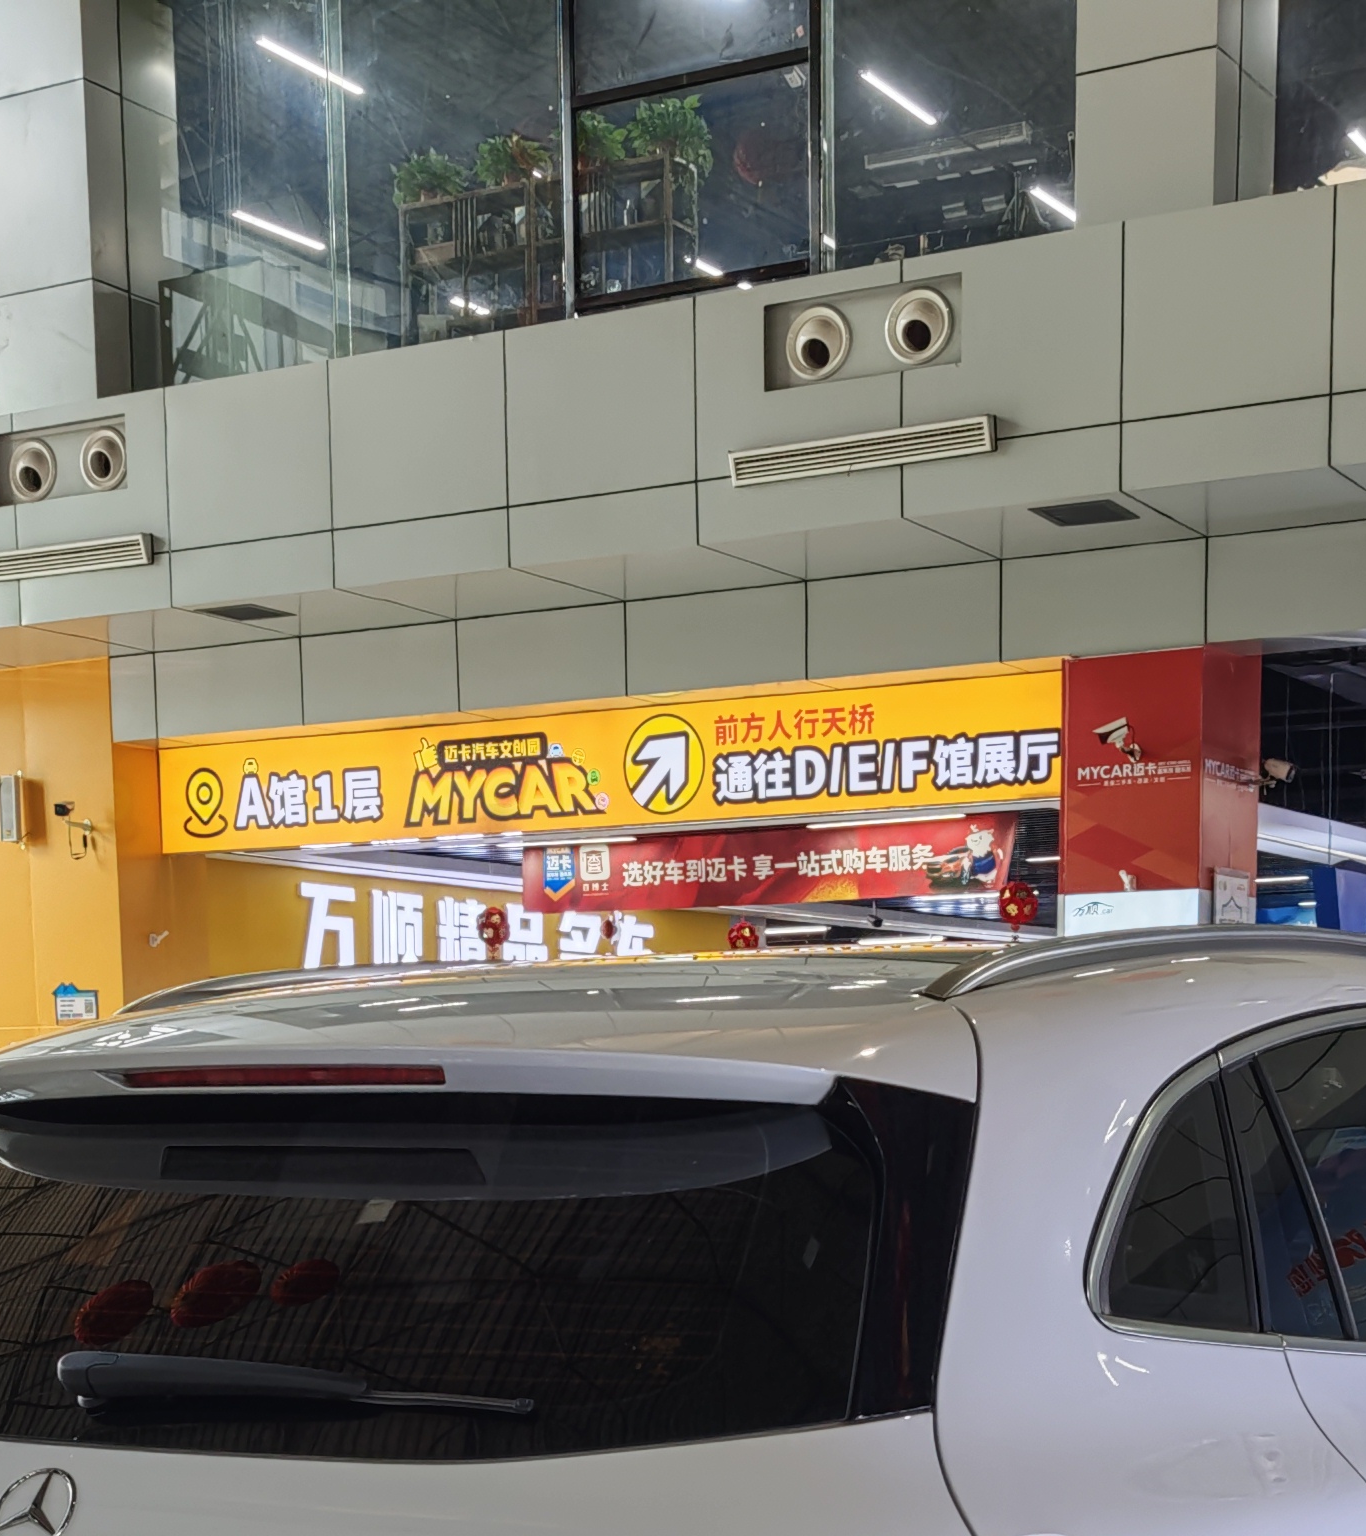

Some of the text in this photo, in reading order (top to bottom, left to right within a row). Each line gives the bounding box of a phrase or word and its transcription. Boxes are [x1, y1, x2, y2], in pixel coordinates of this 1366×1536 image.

[444, 738, 541, 763] 迈卡汽车文创园
[714, 703, 875, 746] 前方人行天桥
[715, 729, 1058, 802] 通往D/E/F馆展厅
[236, 768, 382, 829] A馆1层
[408, 762, 601, 825] MYCAR
[622, 842, 935, 888] 选好车到迈卡 享一站式购车服务
